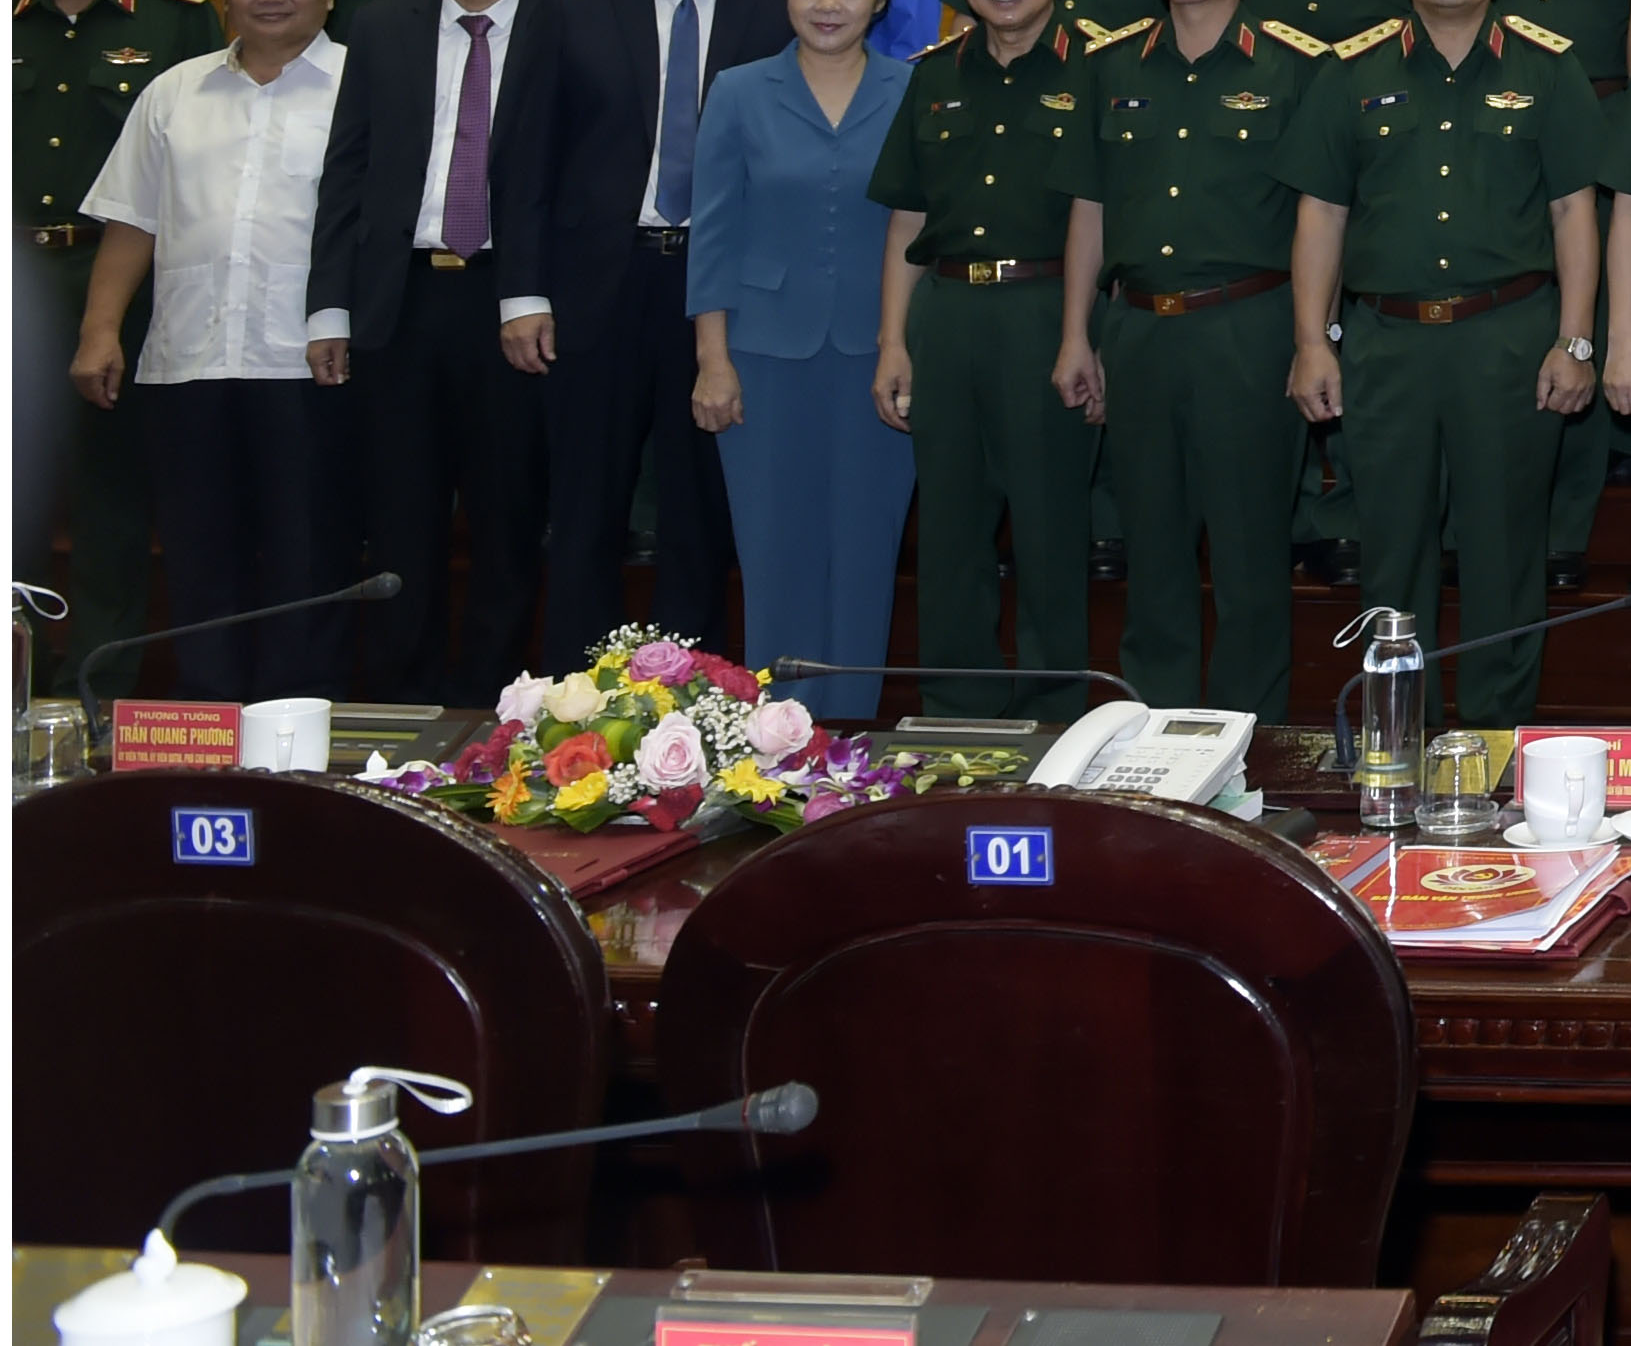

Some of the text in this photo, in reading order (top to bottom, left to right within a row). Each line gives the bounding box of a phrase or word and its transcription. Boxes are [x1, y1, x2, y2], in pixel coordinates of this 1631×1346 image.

[119, 721, 235, 747] TRẦN QUANG PHƯƠNG
[192, 818, 235, 854] 03
[987, 837, 1029, 875] 01
